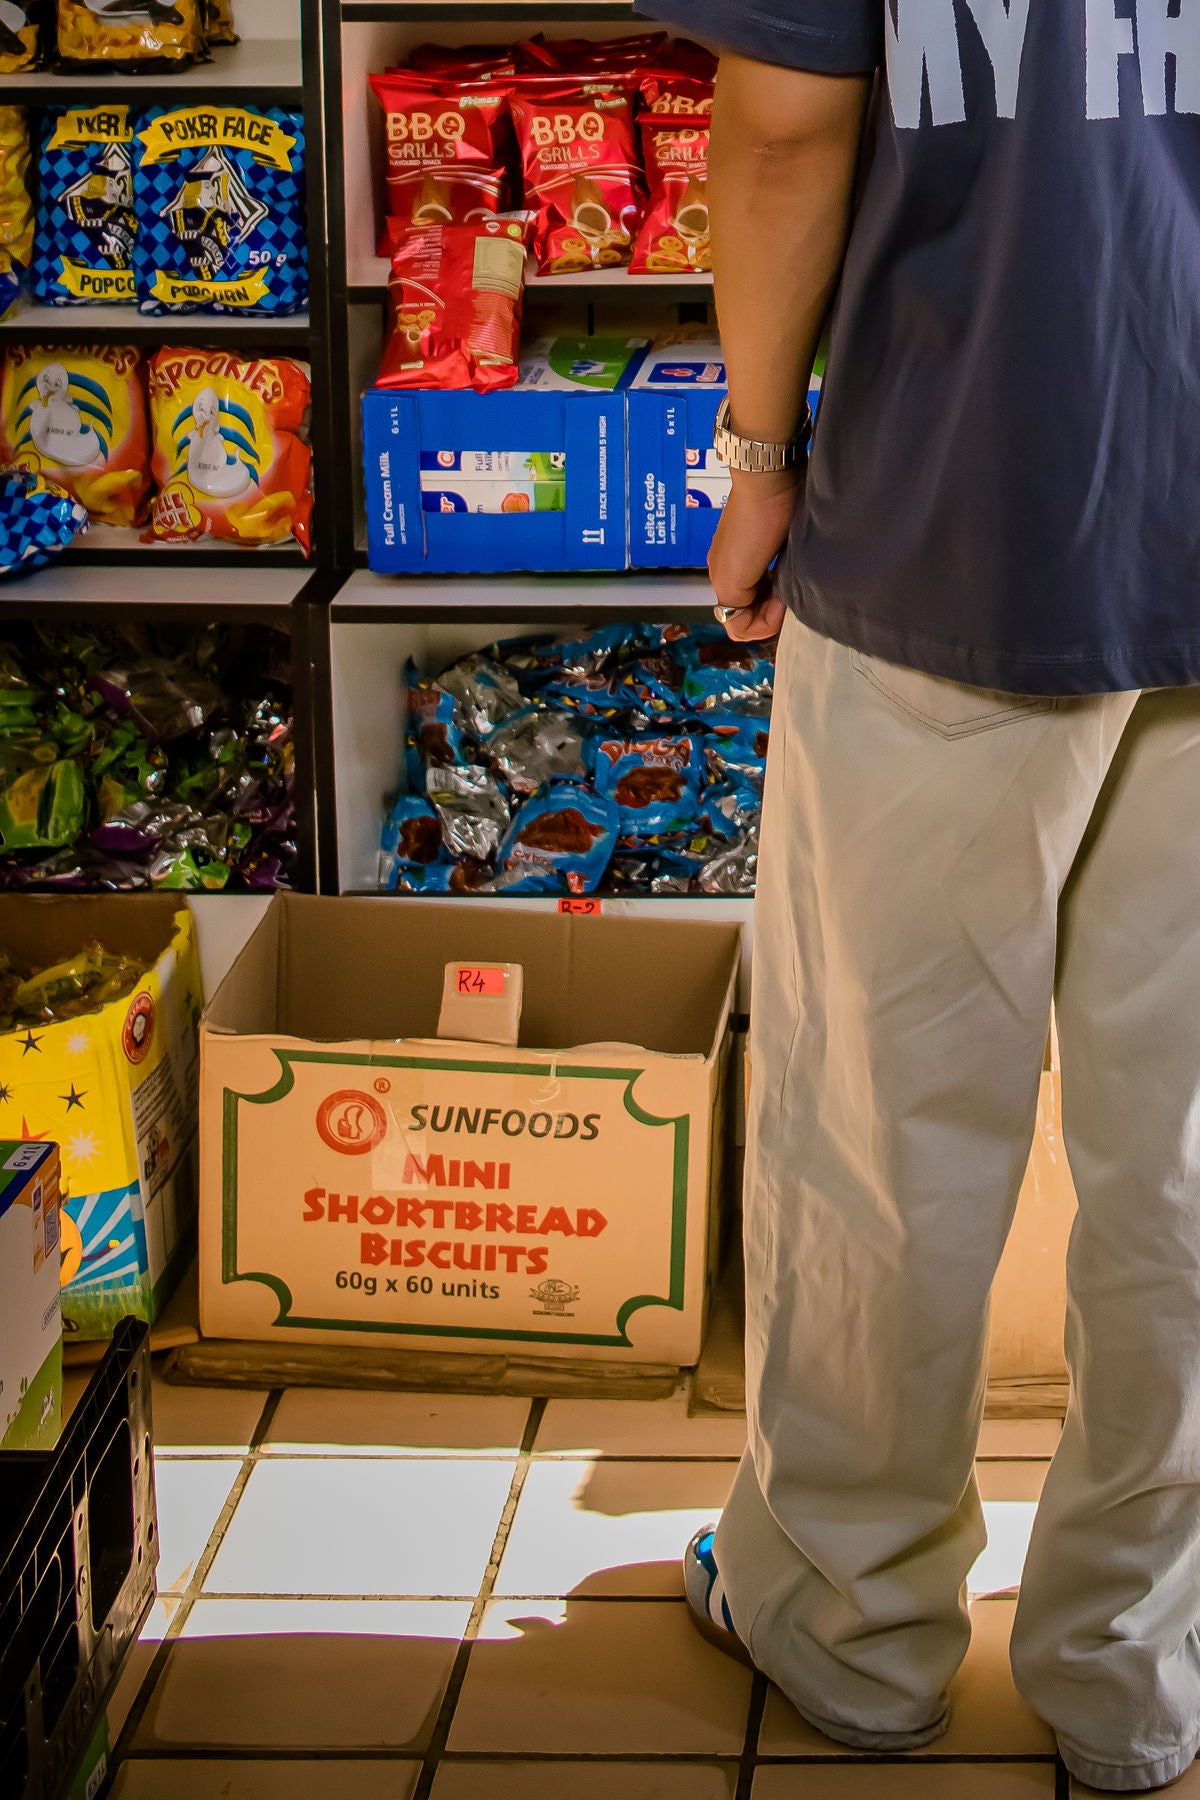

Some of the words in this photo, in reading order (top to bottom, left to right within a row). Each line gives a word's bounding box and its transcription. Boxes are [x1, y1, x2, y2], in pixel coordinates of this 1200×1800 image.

[160, 114, 218, 142] POKER
[222, 115, 275, 147] FACE
[386, 111, 466, 143] BBQ
[531, 111, 605, 146] BBQ
[388, 142, 455, 160] GRILLS
[537, 143, 600, 164] GRILLS
[248, 251, 271, 266] 50
[276, 253, 288, 267] g
[154, 354, 283, 405] SPOOKIES
[379, 450, 391, 478] Milk
[381, 479, 394, 522] Cream
[599, 492, 608, 520] STACK
[643, 472, 656, 512] Gordo
[655, 481, 667, 519] Entier
[384, 523, 396, 546] Full
[644, 513, 656, 545] Leite
[655, 519, 667, 545] Lait
[457, 969, 487, 994] R4
[408, 1103, 602, 1140] SUNFOODS
[402, 1153, 511, 1190] MINI
[301, 1188, 609, 1239] SHORTBREAD
[359, 1232, 549, 1275] BISCUITS
[334, 1270, 380, 1298] 60g
[385, 1277, 399, 1294] x
[405, 1275, 434, 1297] 60
[440, 1276, 501, 1301] units
